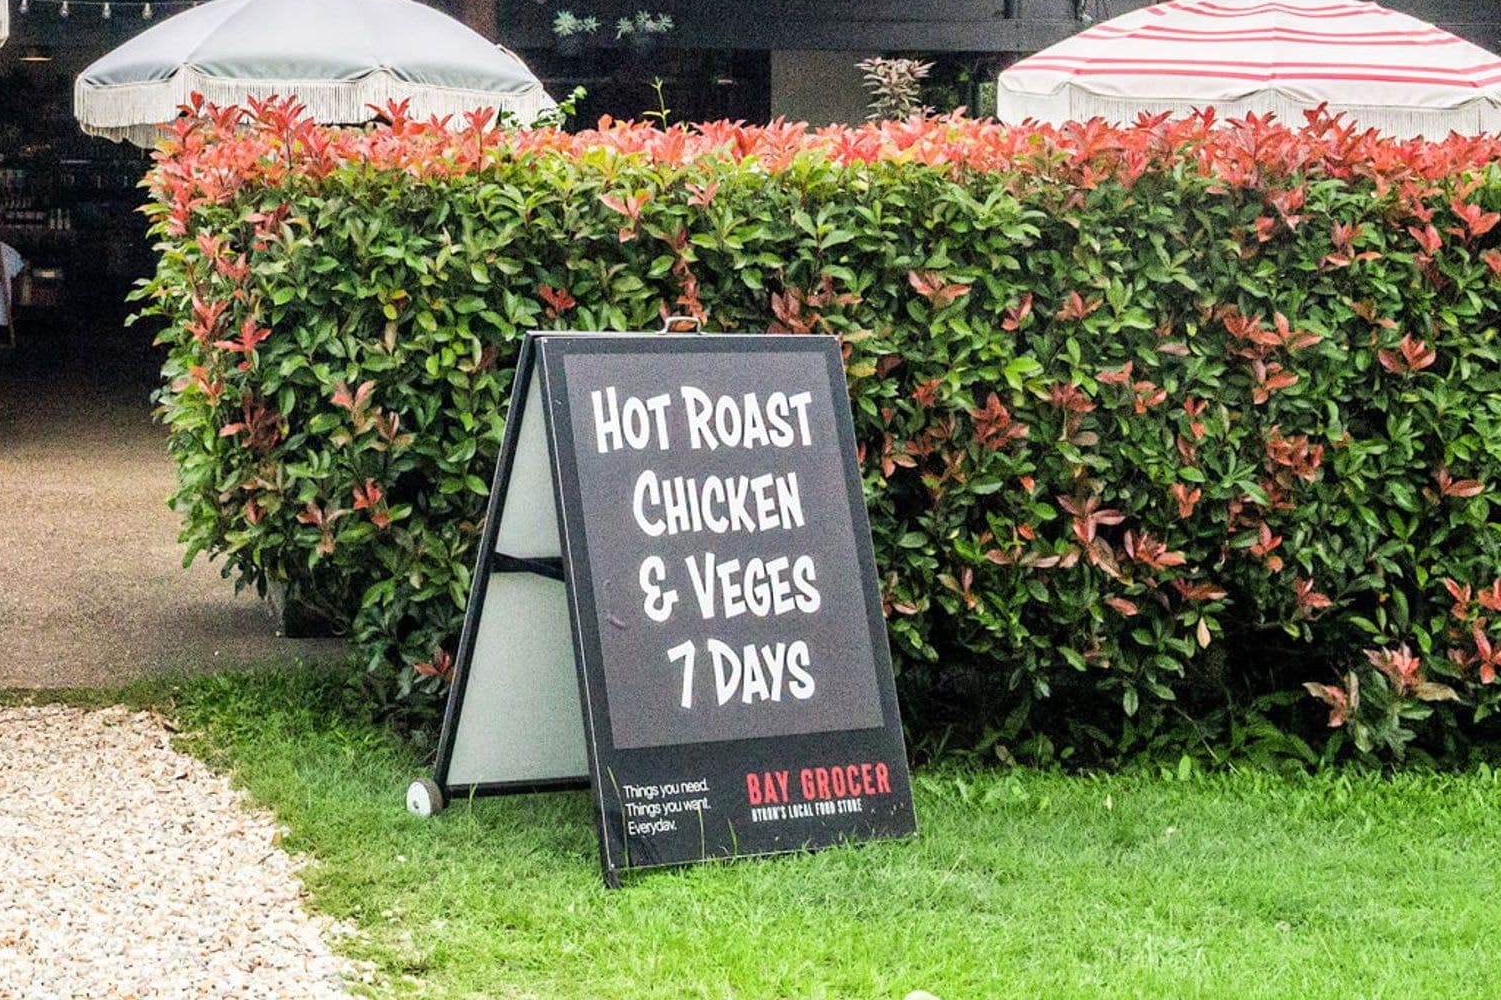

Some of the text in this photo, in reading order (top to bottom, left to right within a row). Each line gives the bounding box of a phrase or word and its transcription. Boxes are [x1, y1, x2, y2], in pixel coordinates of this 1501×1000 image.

[591, 385, 812, 453] HOT ROAST
[633, 470, 805, 537] CHICKEN
[639, 552, 821, 622] & VEGES
[667, 638, 815, 709] 7 DAYS
[622, 778, 710, 800] Things you need.
[746, 762, 891, 805] BAY GROCER
[625, 797, 712, 818] Things you want.
[628, 818, 677, 836] Everyday.
[788, 803, 814, 818] LOCAL
[815, 800, 836, 816] FOOD
[837, 798, 863, 813] STORE
